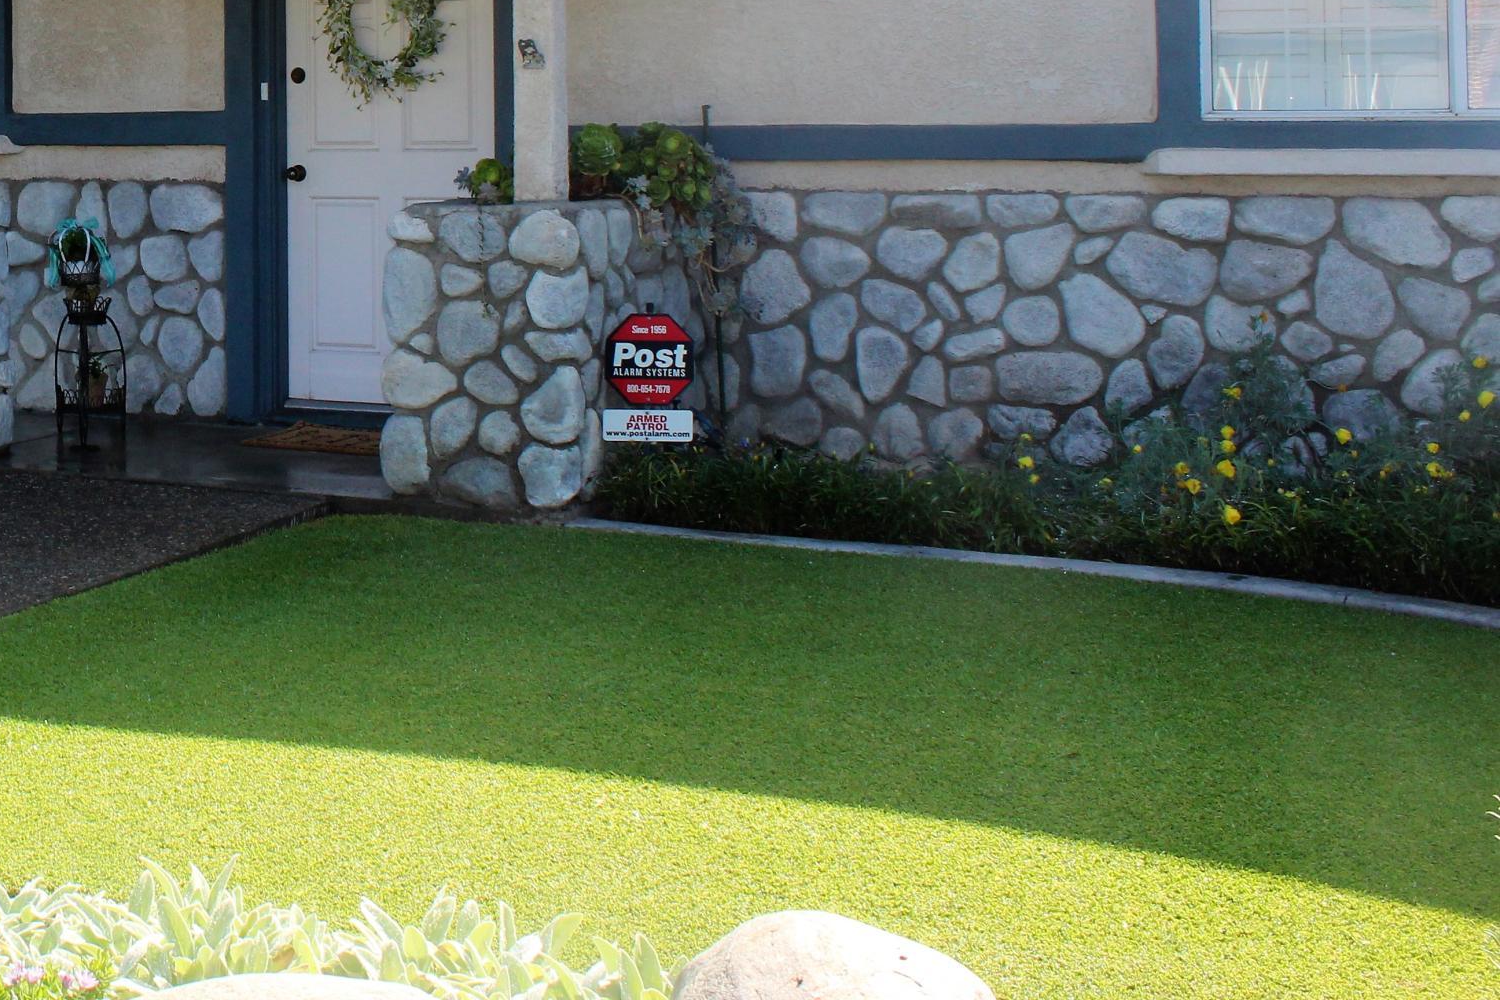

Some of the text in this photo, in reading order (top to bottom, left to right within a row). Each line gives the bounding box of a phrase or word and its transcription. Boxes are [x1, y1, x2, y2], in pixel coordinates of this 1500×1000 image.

[631, 325, 649, 334] Since
[612, 342, 687, 368] Post
[613, 368, 686, 377] ALARM SYSTEMS
[629, 414, 668, 423] ARMED
[626, 422, 669, 431] PATROL
[606, 430, 690, 438] www.postalarm.com
